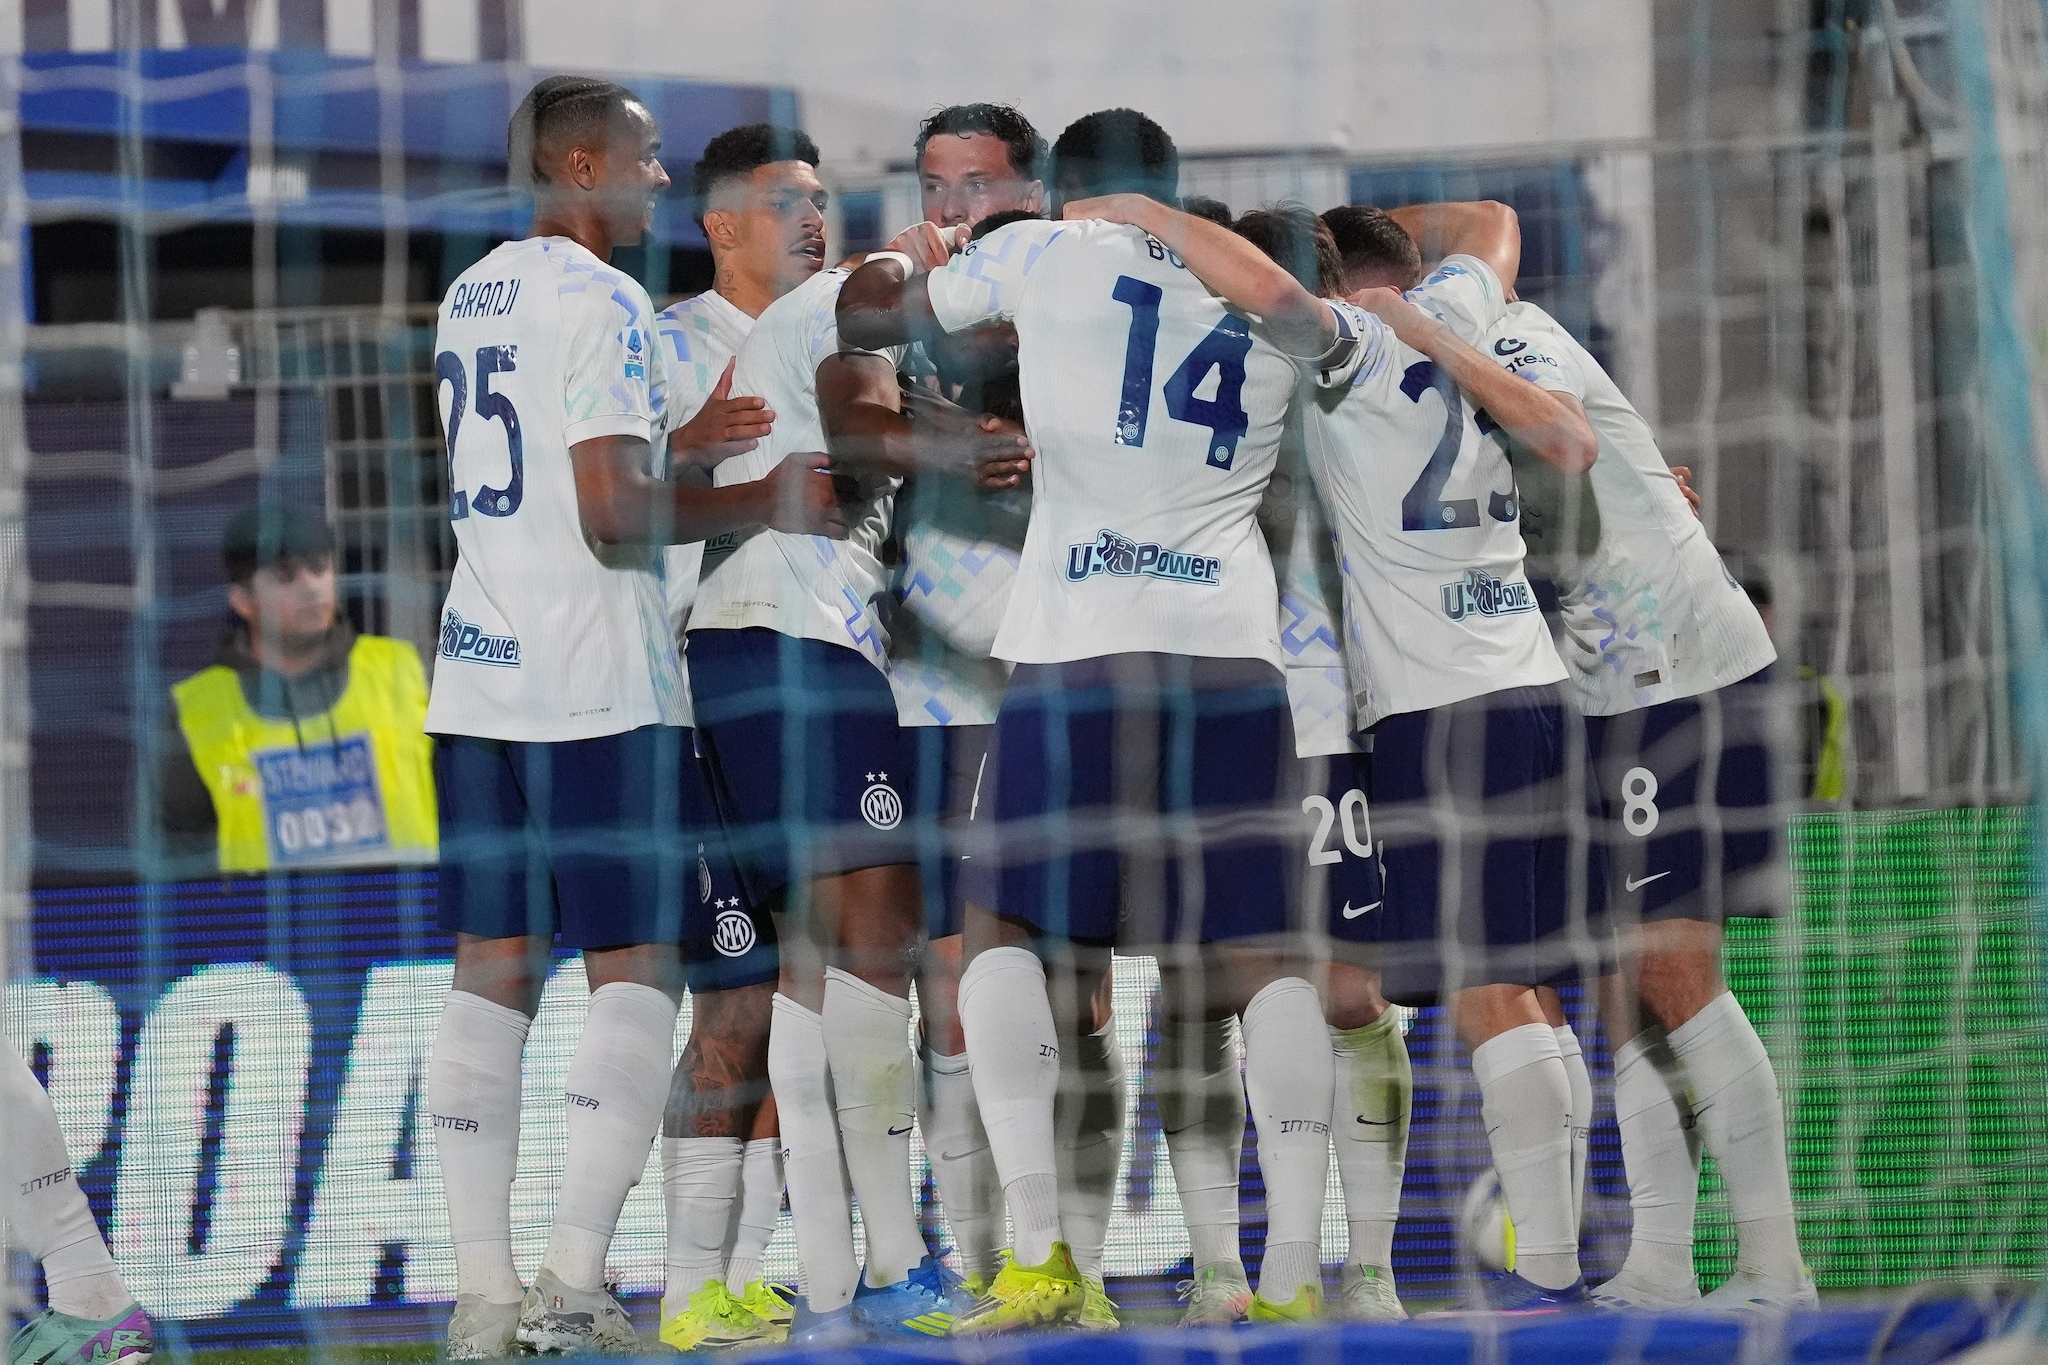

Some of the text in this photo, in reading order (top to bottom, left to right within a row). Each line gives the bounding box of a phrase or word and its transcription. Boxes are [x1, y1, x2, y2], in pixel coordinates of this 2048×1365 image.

[450, 278, 521, 319] AKANJI
[1111, 274, 1254, 471] 14
[1504, 353, 1558, 374] ate.io
[436, 344, 524, 521] 25
[1621, 766, 1659, 837] 8
[1301, 788, 1374, 867] 20
[564, 1092, 600, 1110] NTER
[1280, 1119, 1329, 1137] INTER
[20, 1167, 72, 1196] INTER
